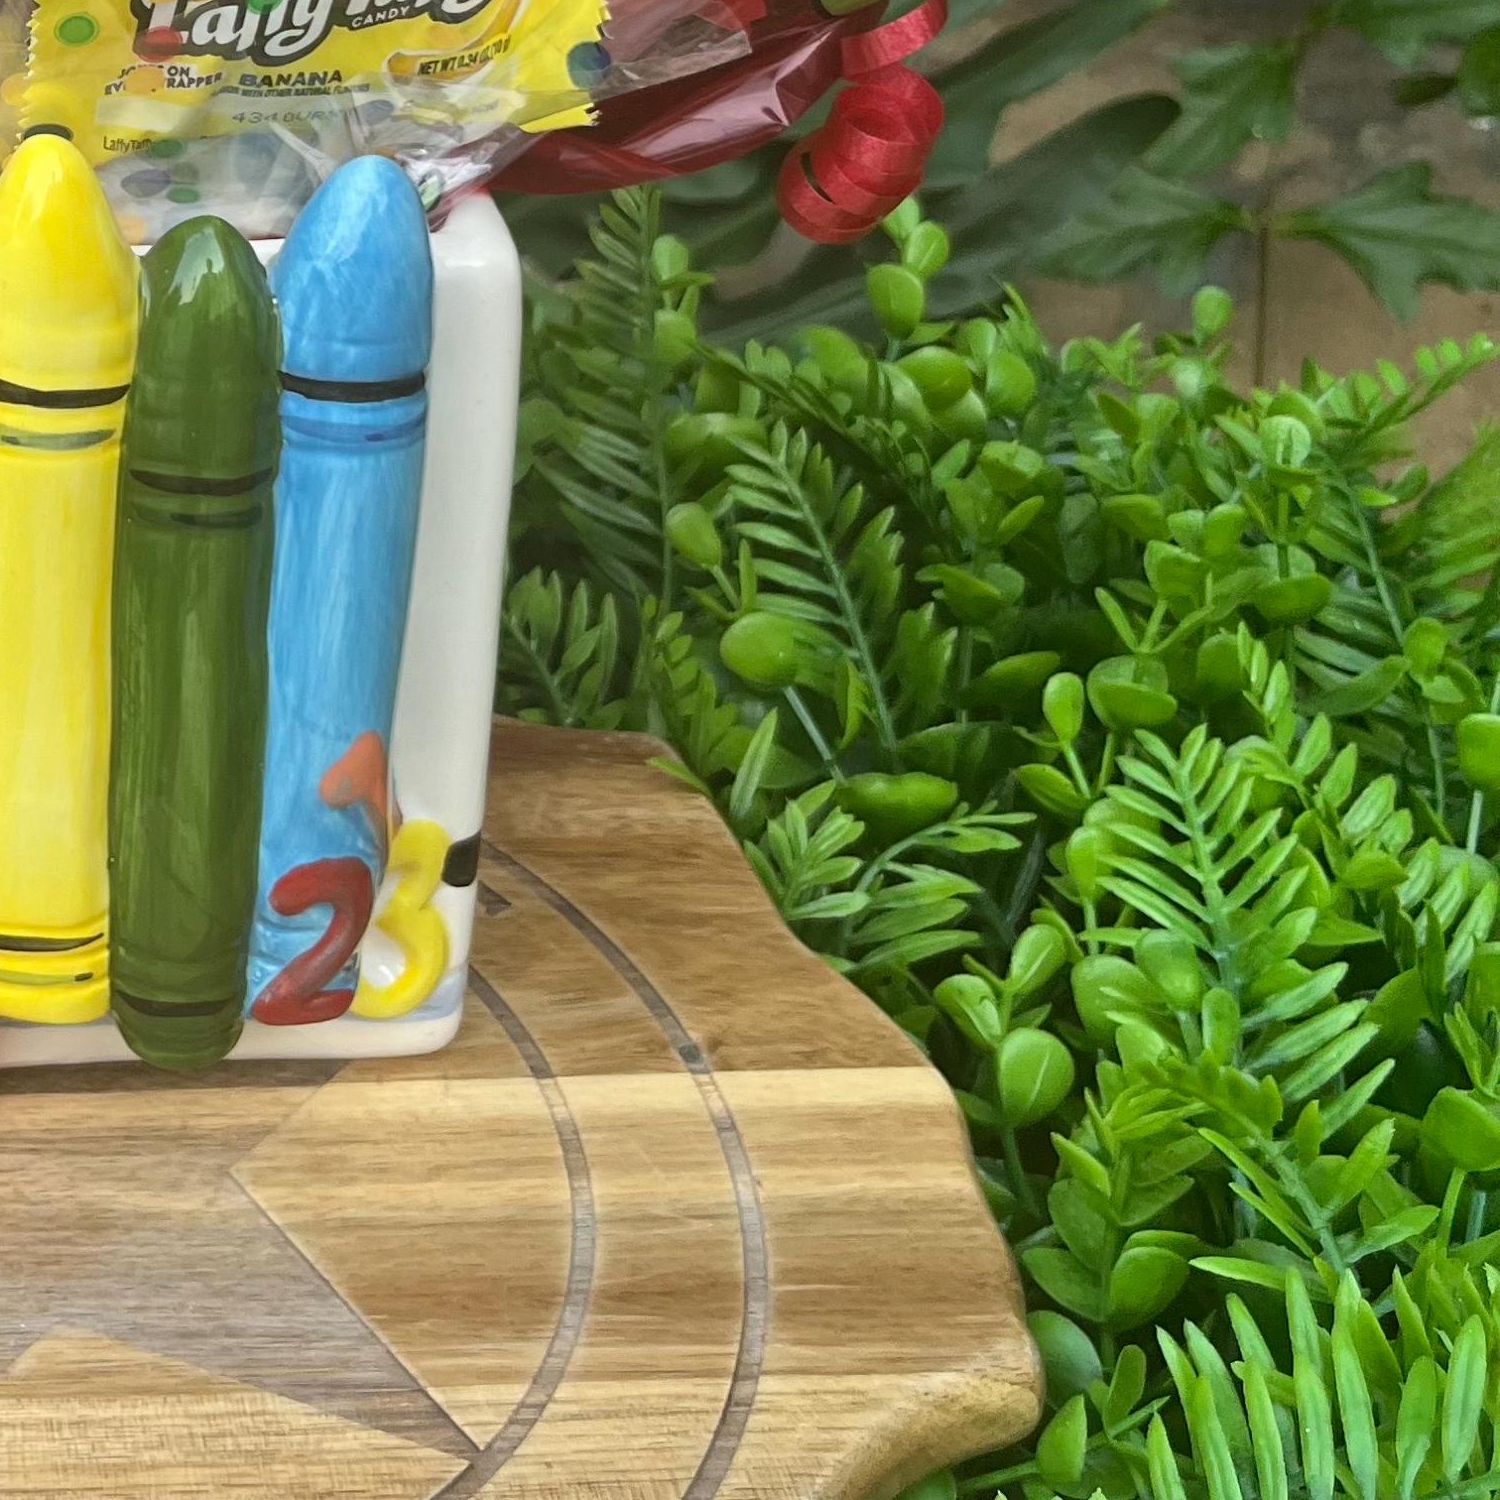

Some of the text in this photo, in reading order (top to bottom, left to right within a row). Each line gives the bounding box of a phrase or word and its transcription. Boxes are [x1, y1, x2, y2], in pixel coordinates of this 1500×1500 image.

[351, 5, 412, 29] CANDY
[166, 71, 223, 89] RAPPER
[167, 65, 190, 78] ON
[238, 69, 343, 88] BANANA
[250, 855, 374, 1026] 2
[350, 818, 450, 1020] 3
